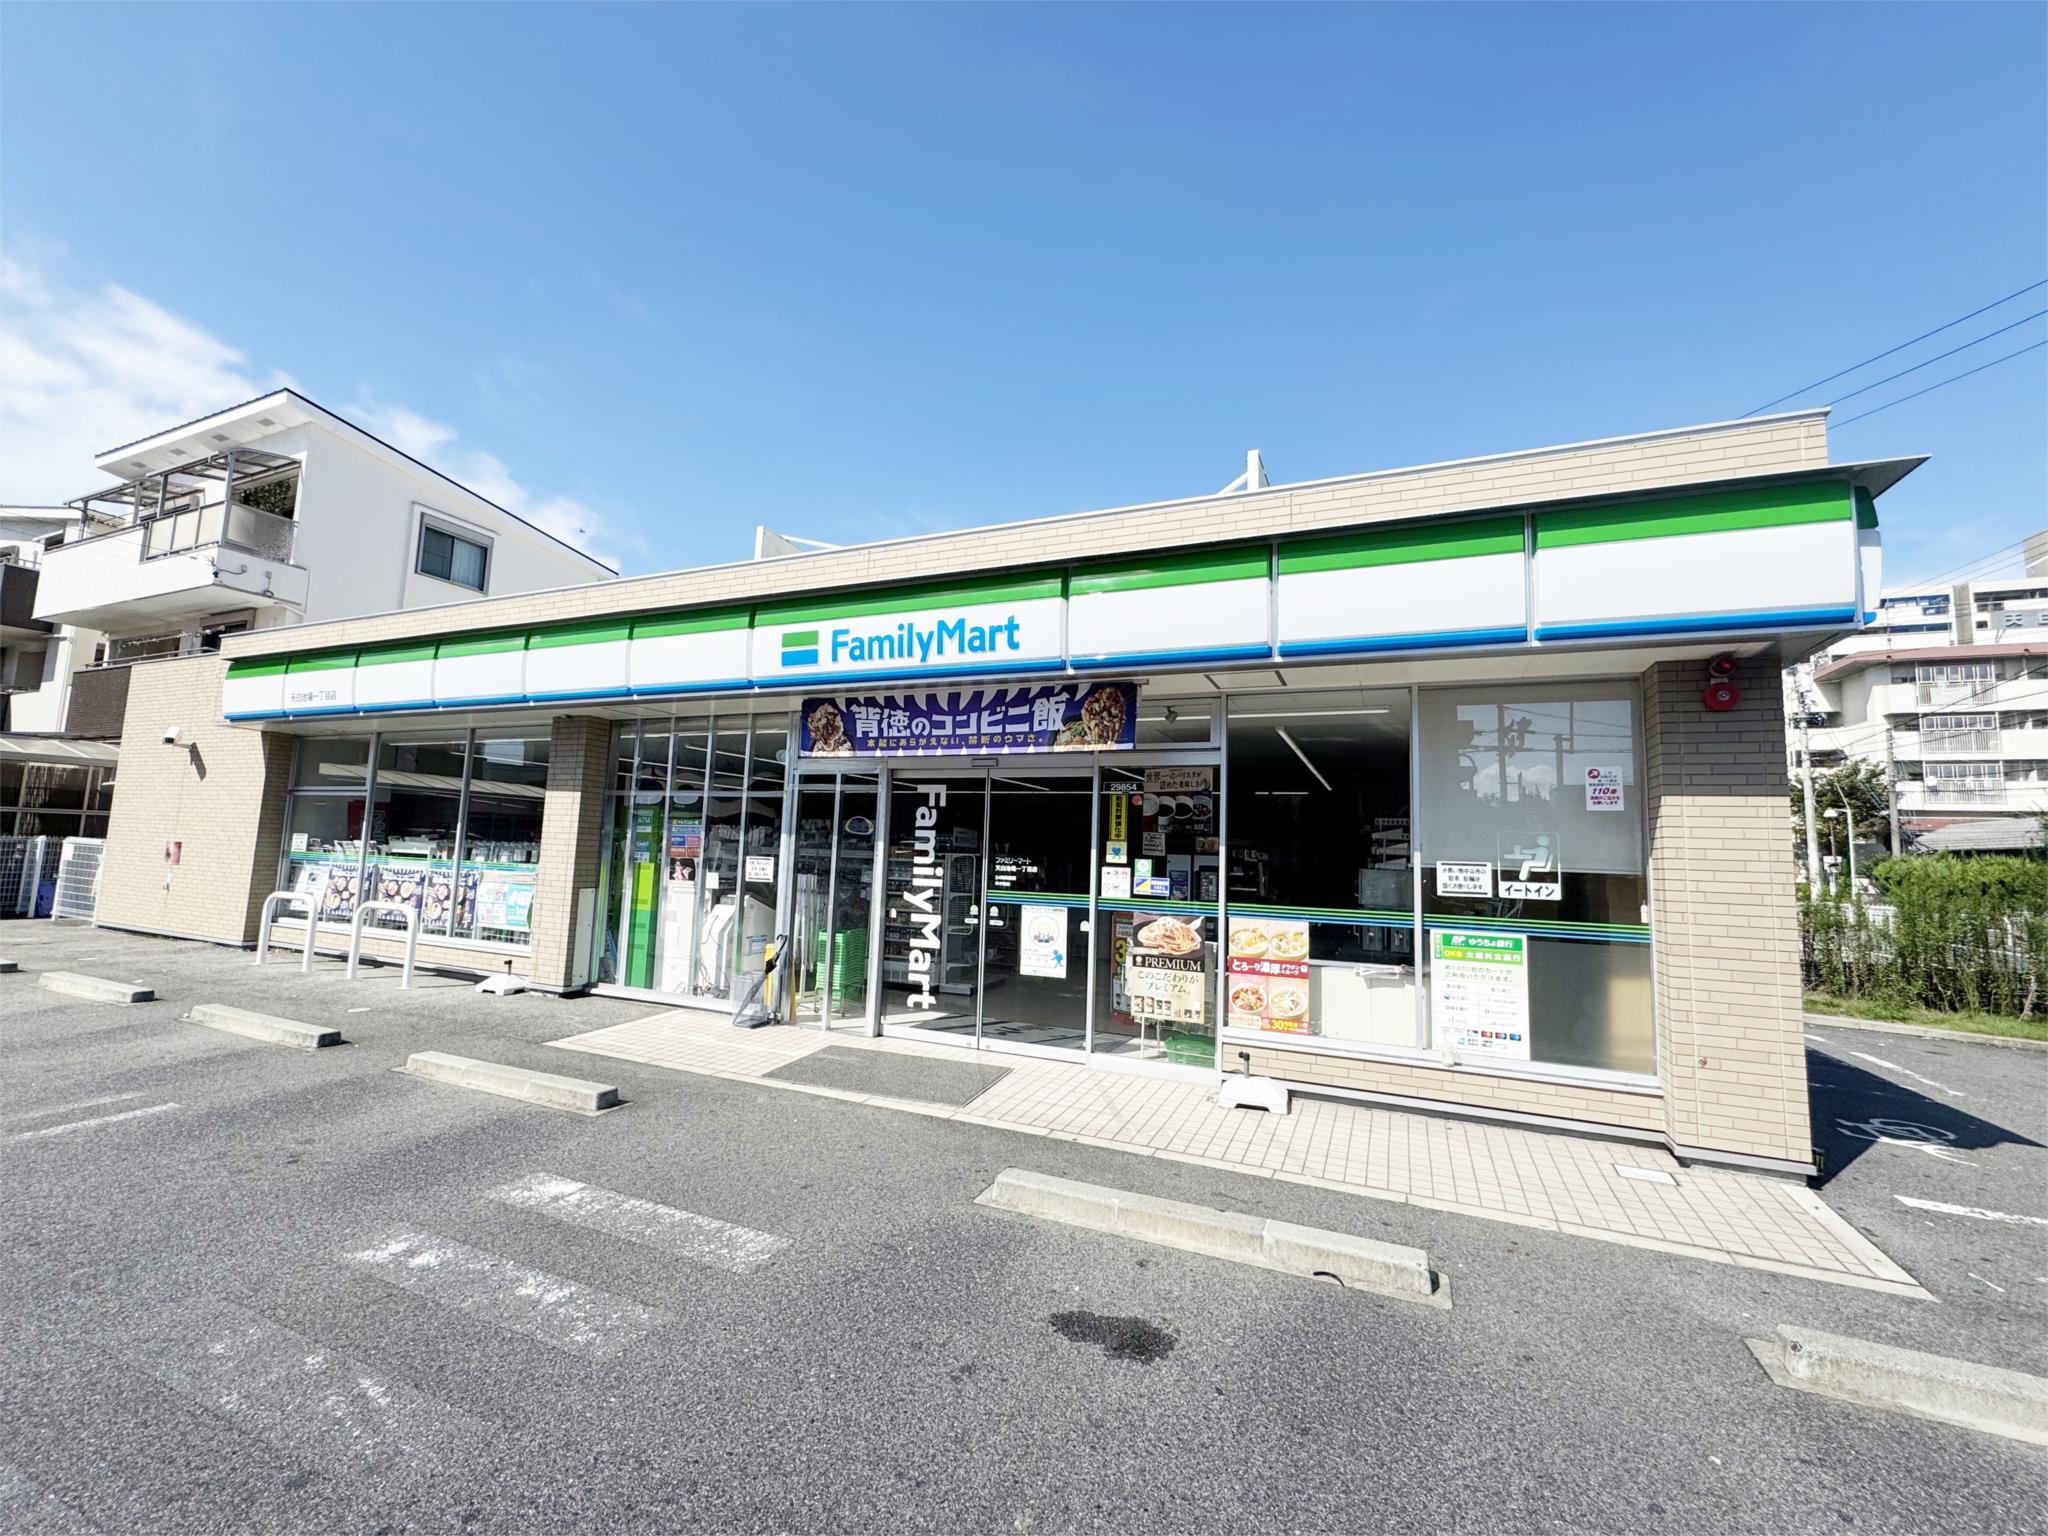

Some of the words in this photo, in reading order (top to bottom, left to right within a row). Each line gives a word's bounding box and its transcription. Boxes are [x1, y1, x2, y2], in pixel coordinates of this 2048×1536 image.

[831, 615, 1020, 664] FamilyMart
[850, 696, 1068, 739] 背徳のコンビニ飯
[1110, 783, 1137, 791] 29854
[995, 856, 1032, 865] ファミリーマート
[903, 784, 948, 1010] FamilyMart
[1504, 884, 1556, 898] イートイン
[1145, 956, 1201, 971] PREMIUM
[1137, 970, 1199, 985] このこだわりが
